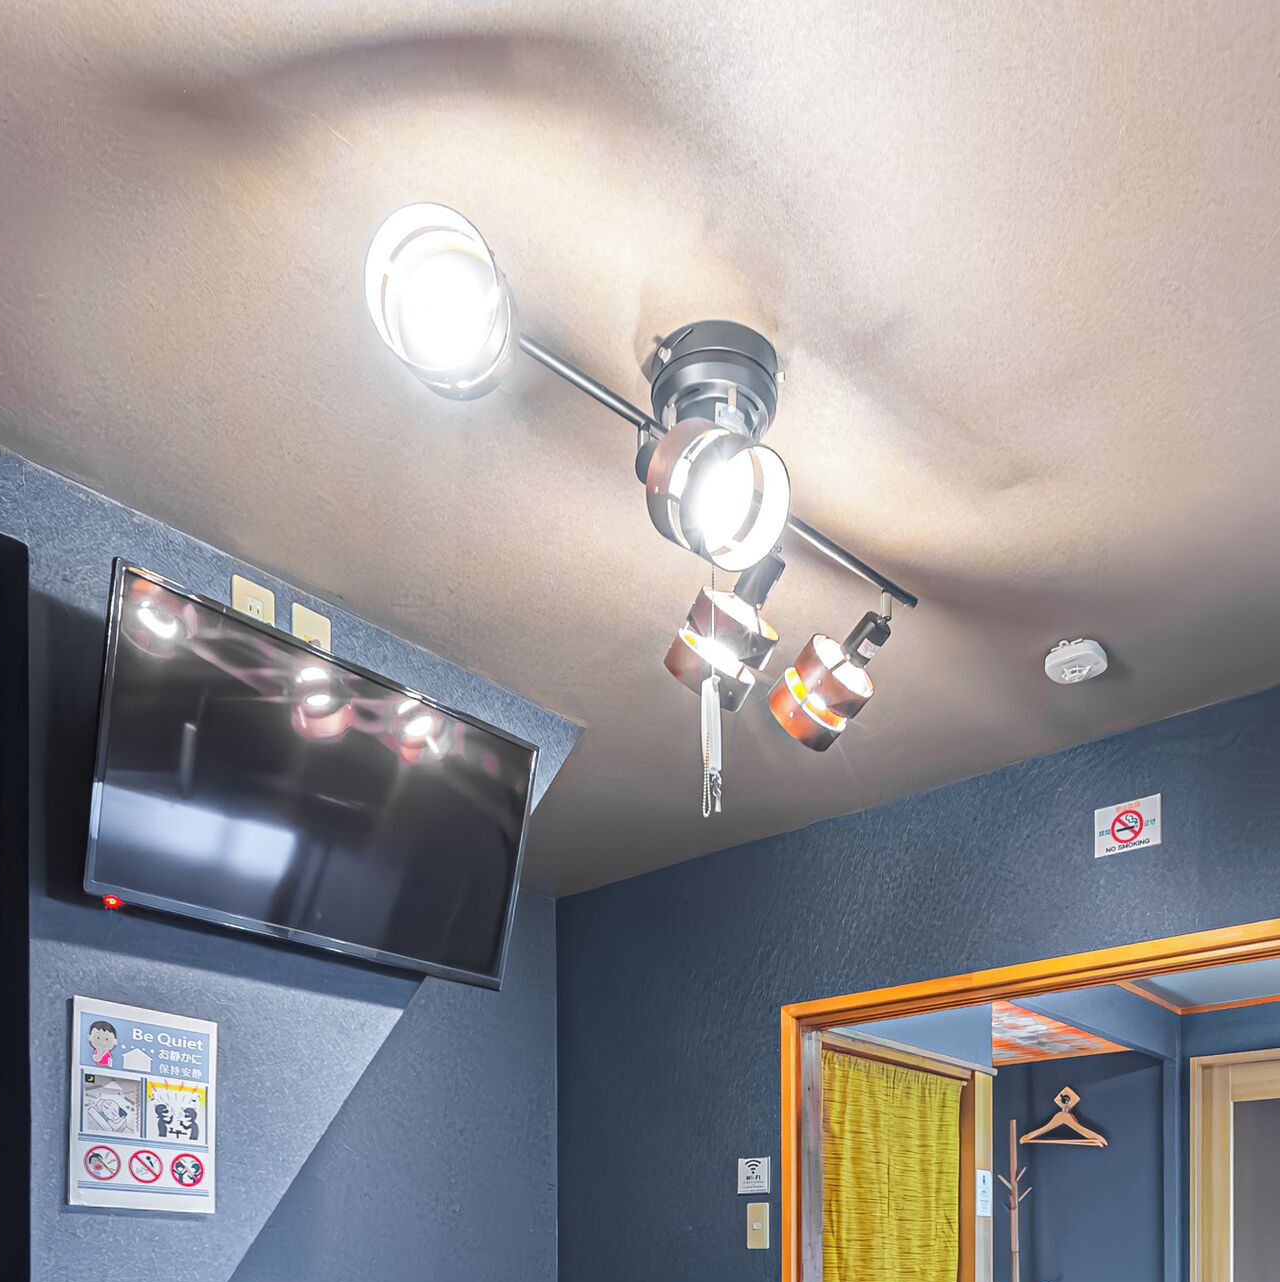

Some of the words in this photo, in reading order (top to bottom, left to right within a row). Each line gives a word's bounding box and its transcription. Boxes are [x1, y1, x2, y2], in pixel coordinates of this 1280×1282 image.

[1117, 838, 1150, 850] SMOKING
[132, 1028, 154, 1043] Be
[157, 1032, 204, 1052] Quiet
[158, 1049, 202, 1065] お静かに
